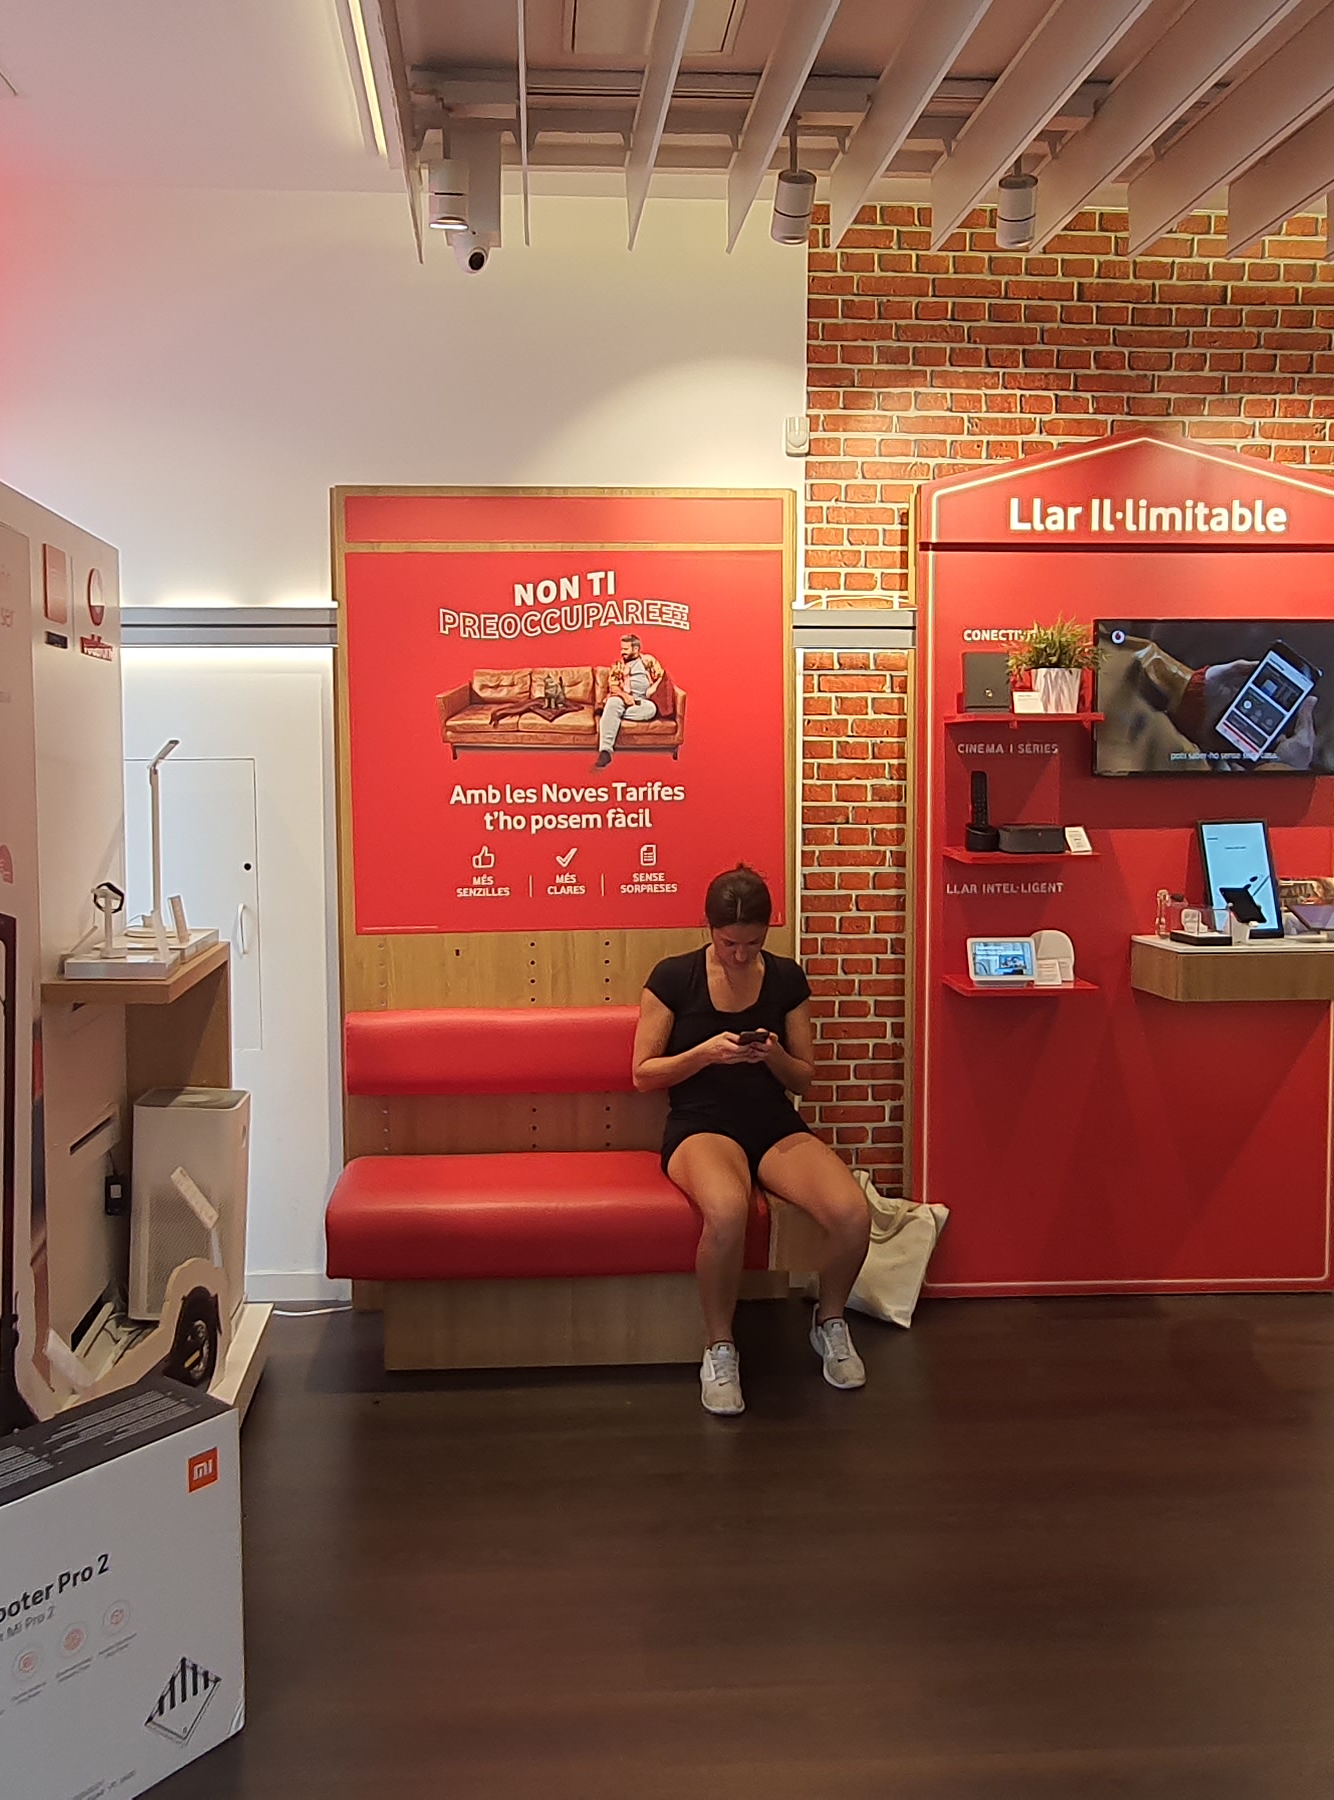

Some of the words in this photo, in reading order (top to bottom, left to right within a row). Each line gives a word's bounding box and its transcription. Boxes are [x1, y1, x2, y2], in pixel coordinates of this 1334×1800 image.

[1009, 497, 1083, 531] Llar
[1090, 498, 1288, 532] Il·limitable
[513, 574, 581, 607] NON
[586, 570, 616, 597] TI
[963, 628, 1036, 642] CONECTI
[957, 743, 1004, 755] CINEMA
[1008, 744, 1014, 754] I
[450, 784, 501, 805] Amb
[505, 784, 538, 804] les
[542, 783, 609, 803] Noves
[612, 781, 686, 803] Tarifes
[530, 811, 603, 835] posem
[606, 807, 653, 829] fàcil
[472, 874, 495, 885] MÉS
[555, 872, 577, 884] MÉS
[632, 872, 665, 882] SENSE
[456, 886, 511, 898] SENZILLES
[547, 885, 586, 896] CLARES
[620, 882, 679, 894] SORPRESES
[946, 883, 978, 895] LLAR
[57, 1566, 94, 1595] Pro
[97, 1554, 111, 1575] 2
[24, 1612, 46, 1629] Pro
[46, 1605, 57, 1621] 2
